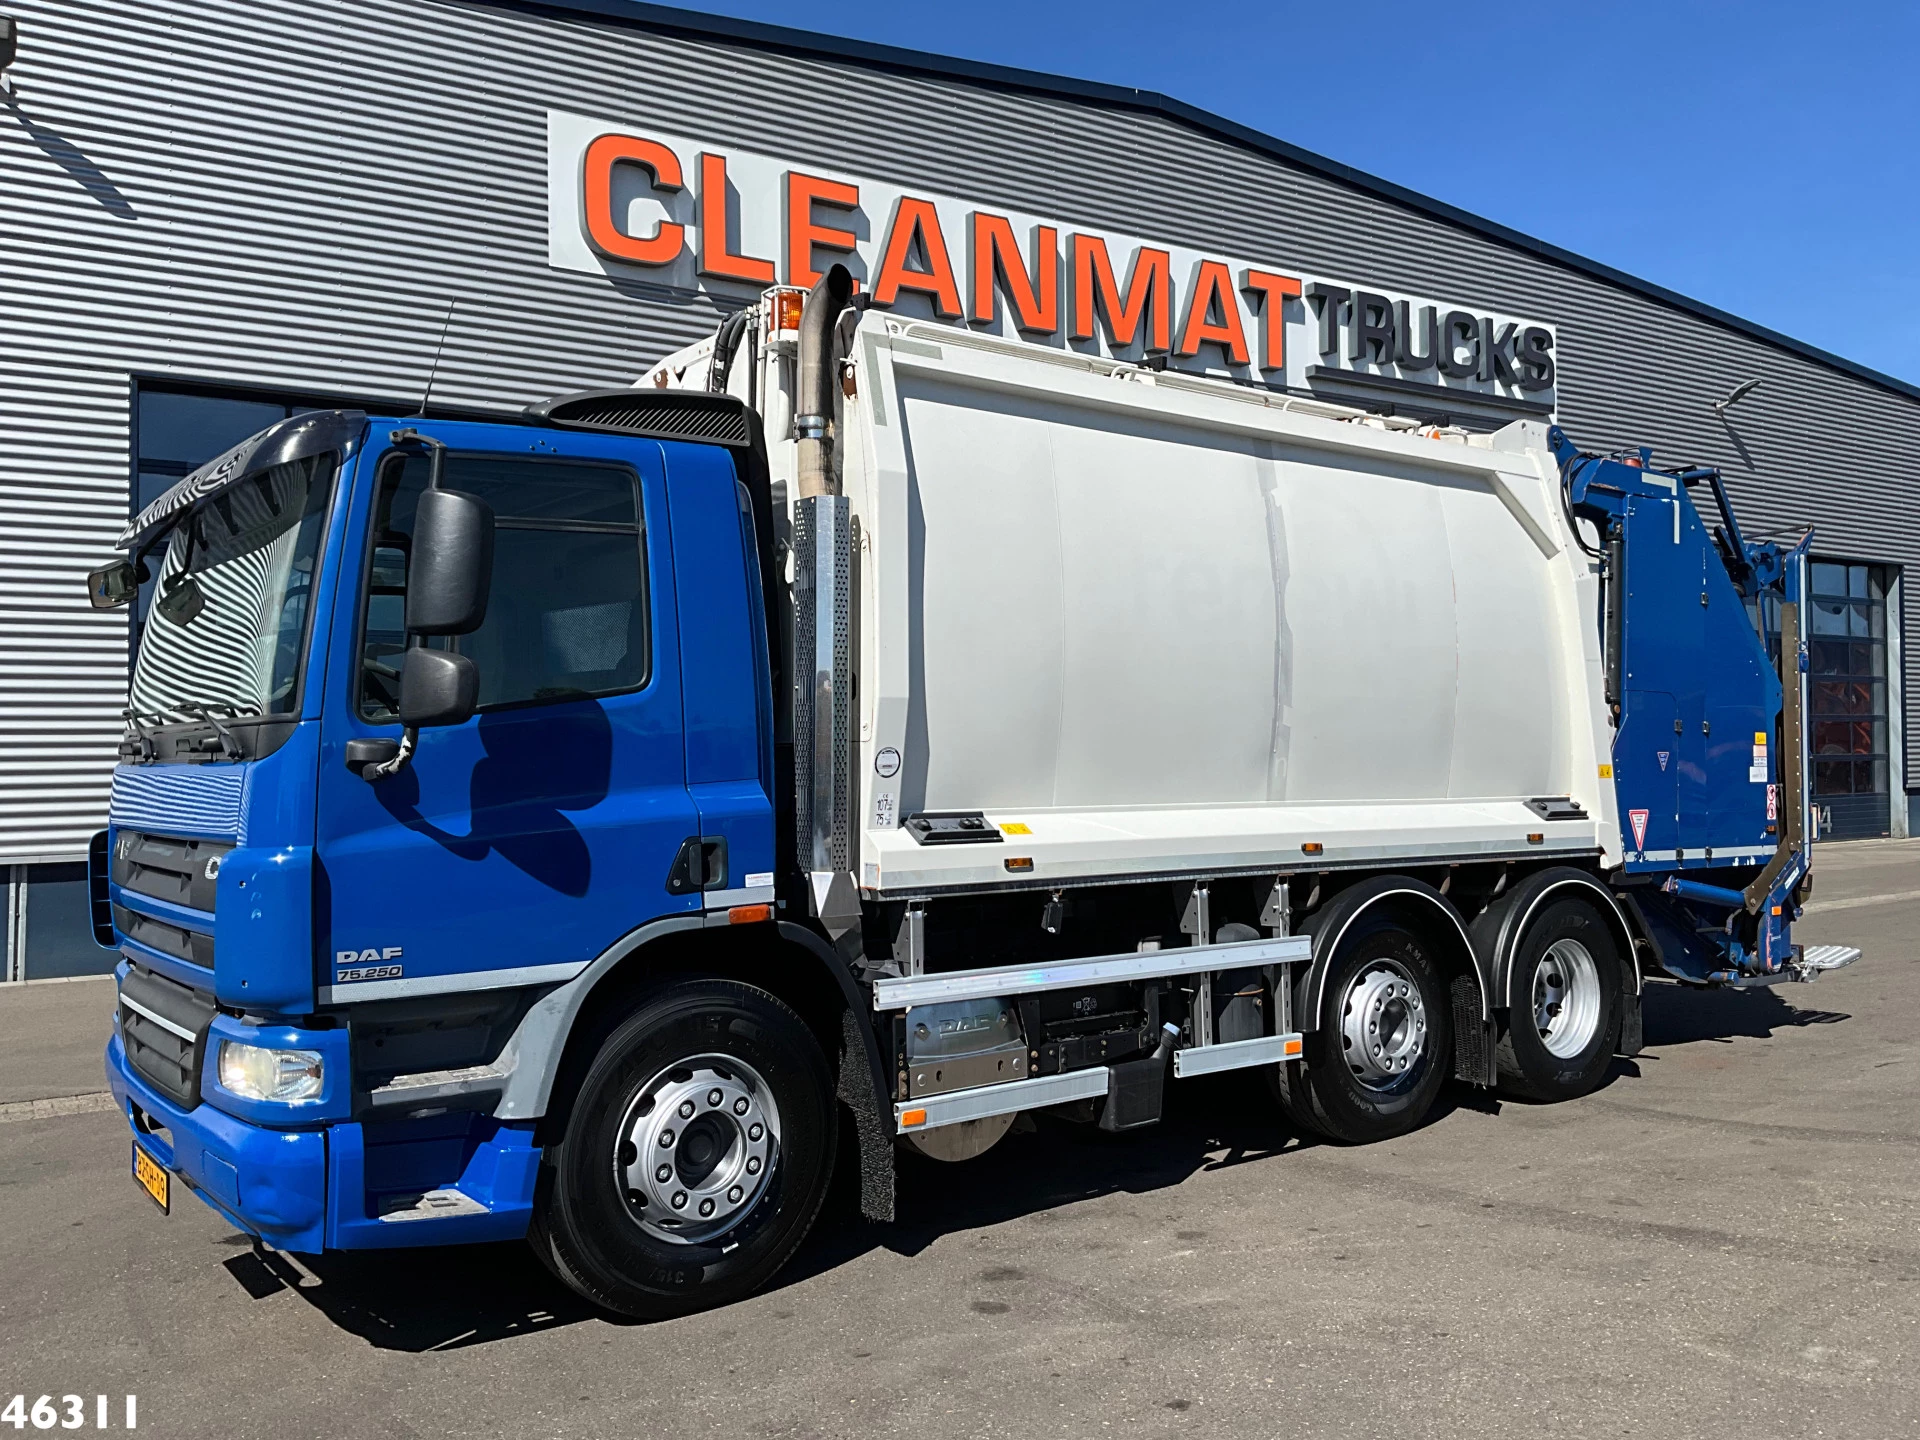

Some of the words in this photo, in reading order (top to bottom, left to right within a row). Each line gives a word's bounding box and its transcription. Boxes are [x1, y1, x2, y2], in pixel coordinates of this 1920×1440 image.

[581, 133, 1301, 371] CLEANMAT
[1305, 282, 1555, 391] TRUCKS
[337, 947, 402, 963] DAF
[338, 966, 401, 981] 75.250
